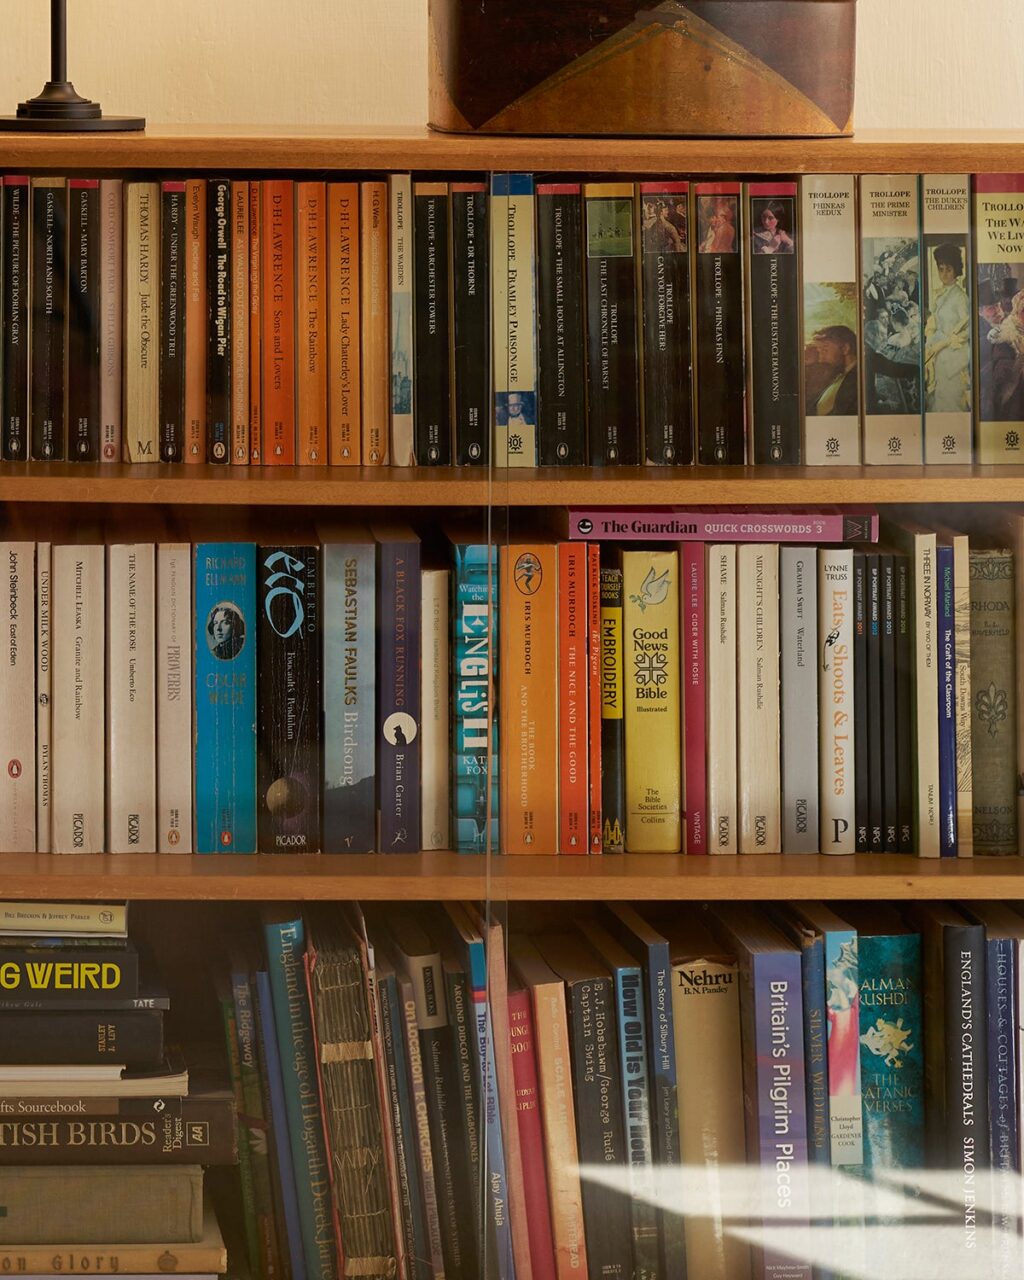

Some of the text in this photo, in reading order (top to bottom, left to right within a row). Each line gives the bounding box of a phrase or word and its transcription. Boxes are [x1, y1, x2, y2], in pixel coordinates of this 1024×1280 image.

[46, 193, 54, 229] GASKELL
[80, 192, 88, 293] GASKELL MARY BARTON
[554, 207, 562, 250] TROLLOPE
[467, 195, 476, 296] TROLLOPE DR THORNE
[215, 185, 226, 356] George Orwell The Road to Wigan Pier
[555, 258, 563, 274] THE
[12, 276, 19, 287] OF
[139, 193, 150, 369] THOMAS HARDY Jude the Obscure
[556, 305, 564, 334] HOUSE
[714, 256, 723, 364] TROLLOPE PHINEAS FINN
[273, 310, 283, 390] Sons and Lovers
[557, 336, 564, 346] AT
[557, 348, 565, 397] ALLINGTON
[601, 521, 697, 534] The Guardian
[704, 523, 811, 534] QUICK CROSSWORDS
[9, 551, 19, 573] John
[825, 564, 848, 572] LYNNE
[826, 573, 848, 581] TRUSS
[9, 575, 19, 620] Steinbeck
[568, 580, 576, 637] MURDOCH
[971, 601, 1010, 611] RHODA
[9, 624, 17, 638] East
[40, 571, 49, 672] UNDER MILK WOOD
[633, 628, 668, 640] Good
[944, 630, 952, 641] The
[395, 571, 405, 706] BLACK FOX RUNNING
[633, 640, 668, 652] News
[944, 643, 952, 659] Craft
[9, 647, 17, 666] Eden
[602, 619, 616, 708] EMBROIDERY
[340, 559, 358, 785] SEBASTIAN FAULKS Birdsong
[636, 687, 667, 699] Bible
[832, 644, 848, 797] Shoots & Leaves
[395, 754, 404, 817] Brian Carter
[974, 806, 1013, 815] NELSON
[693, 811, 701, 844] VINTAGE
[25, 962, 121, 990] WEIRD
[678, 969, 733, 986] Nehru
[133, 999, 155, 1008] TATE
[622, 974, 639, 1016] How
[658, 984, 667, 1008] Story
[236, 983, 254, 1068] The Ridgeway
[660, 1009, 667, 1018] of
[580, 985, 596, 1082] Captain Swing
[624, 1021, 642, 1048] Old
[660, 1020, 668, 1050] Silbury
[662, 1052, 670, 1069] Hill
[278, 929, 326, 1233] England in the age of Hogarth Derek
[627, 1077, 645, 1112] Your
[769, 980, 792, 1209] Britain's Pilgrim Places
[18, 1101, 86, 1112] Sourcebook
[960, 950, 977, 1248] ENGLAND'S CATHEDRALS SIMON JENKINS
[67, 1121, 157, 1146] BIRDS
[491, 1172, 505, 1226] Ajay Ahuja
[52, 1253, 118, 1274] Glory
